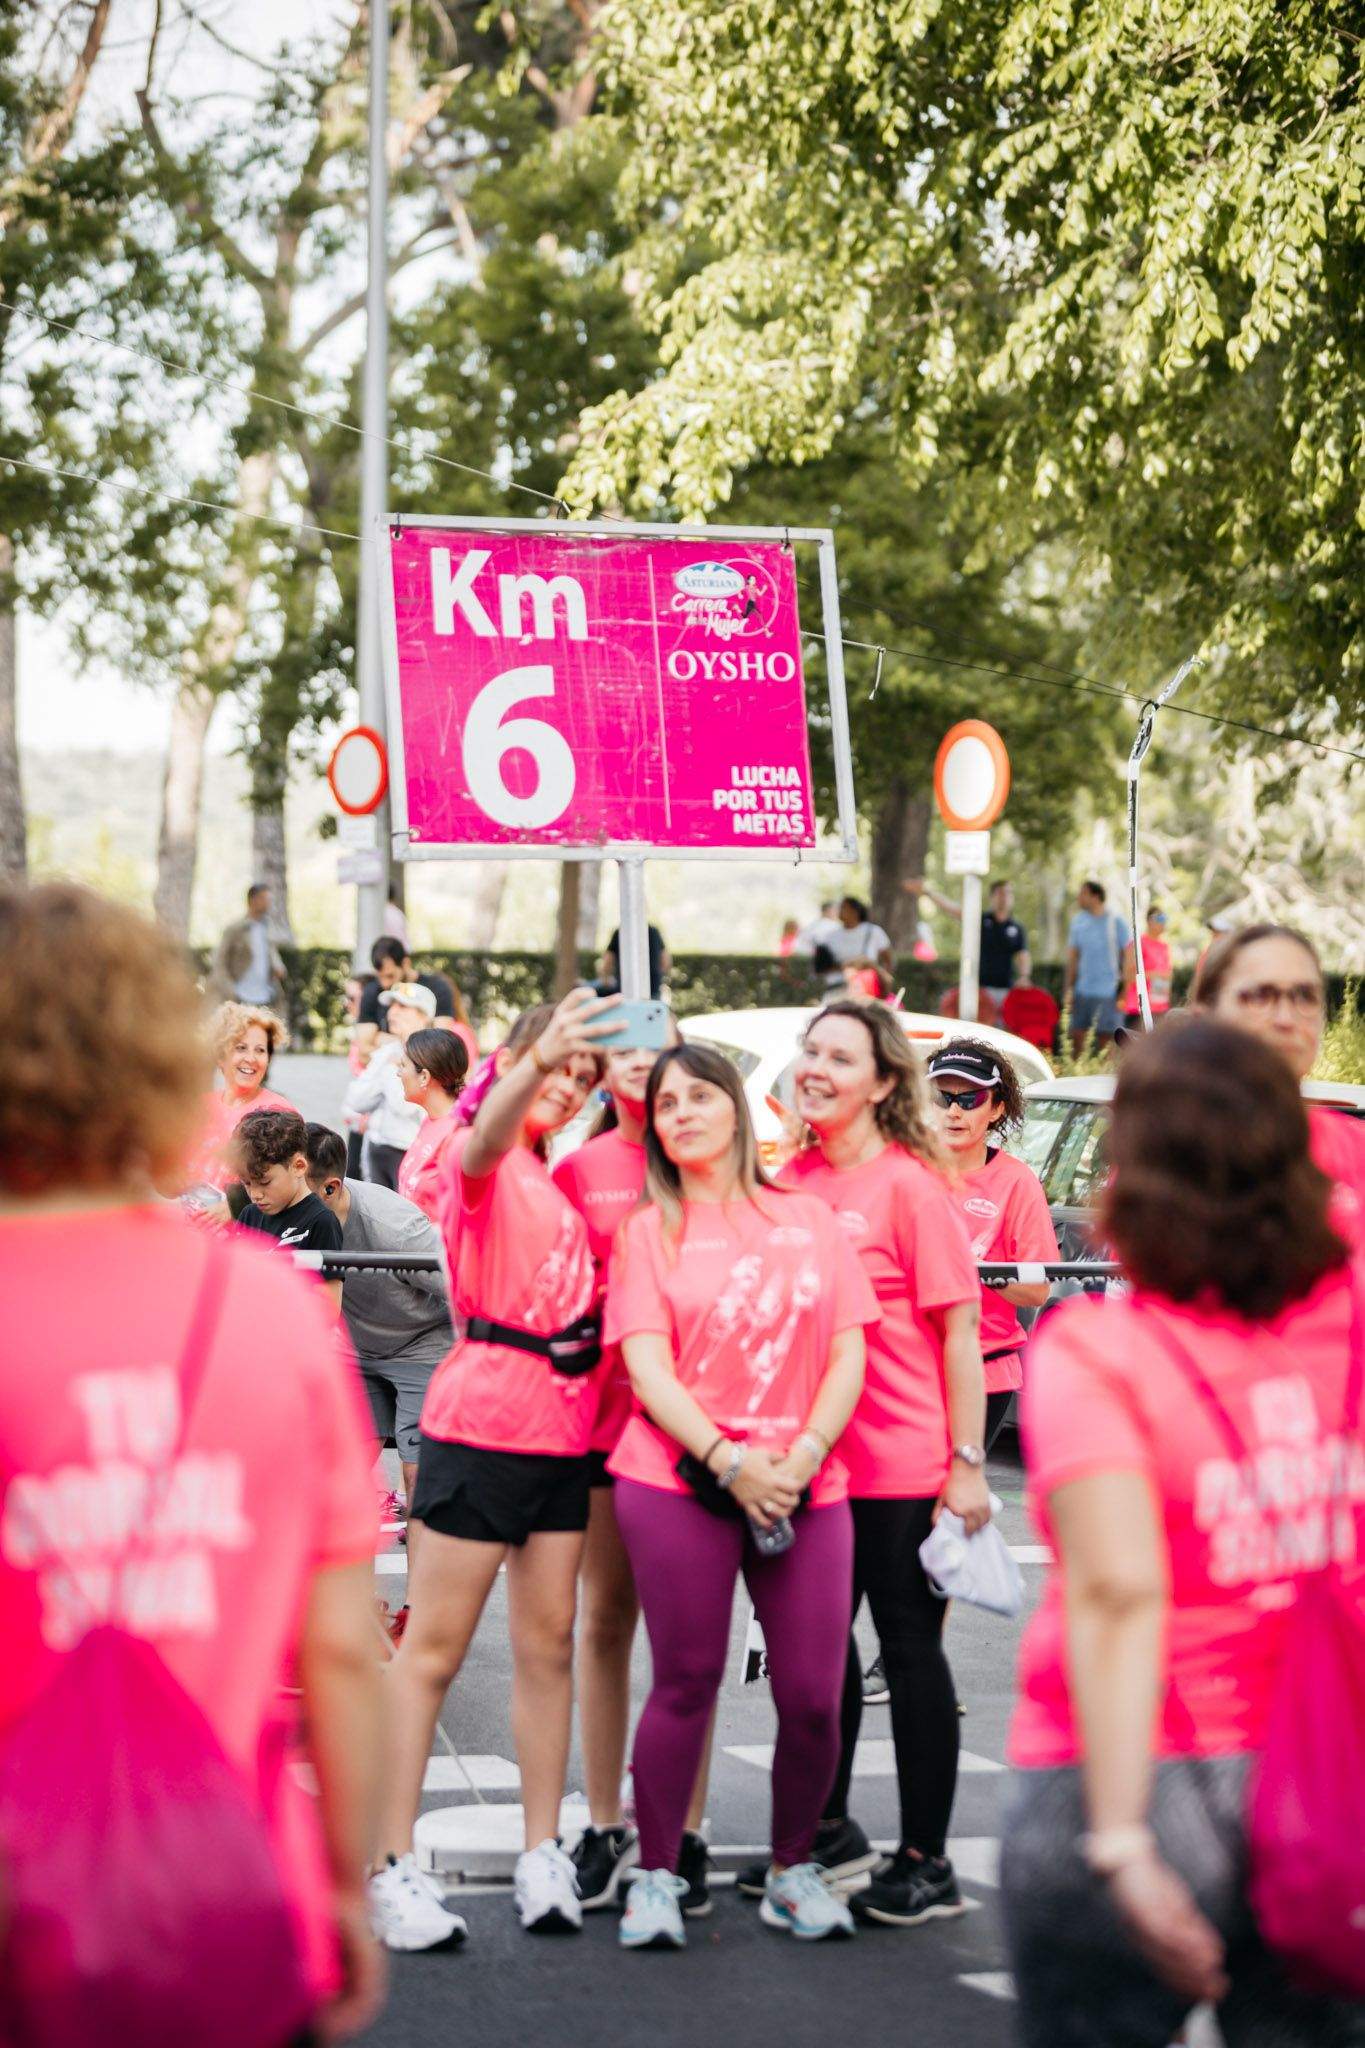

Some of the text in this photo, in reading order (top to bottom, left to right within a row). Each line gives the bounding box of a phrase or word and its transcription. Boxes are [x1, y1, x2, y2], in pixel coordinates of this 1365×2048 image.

[430, 547, 588, 641] Km
[668, 650, 795, 682] OYSHO
[462, 665, 576, 829] 6
[731, 765, 802, 788] LUCHA
[712, 788, 804, 811] POR TUS
[733, 813, 806, 835] METAS
